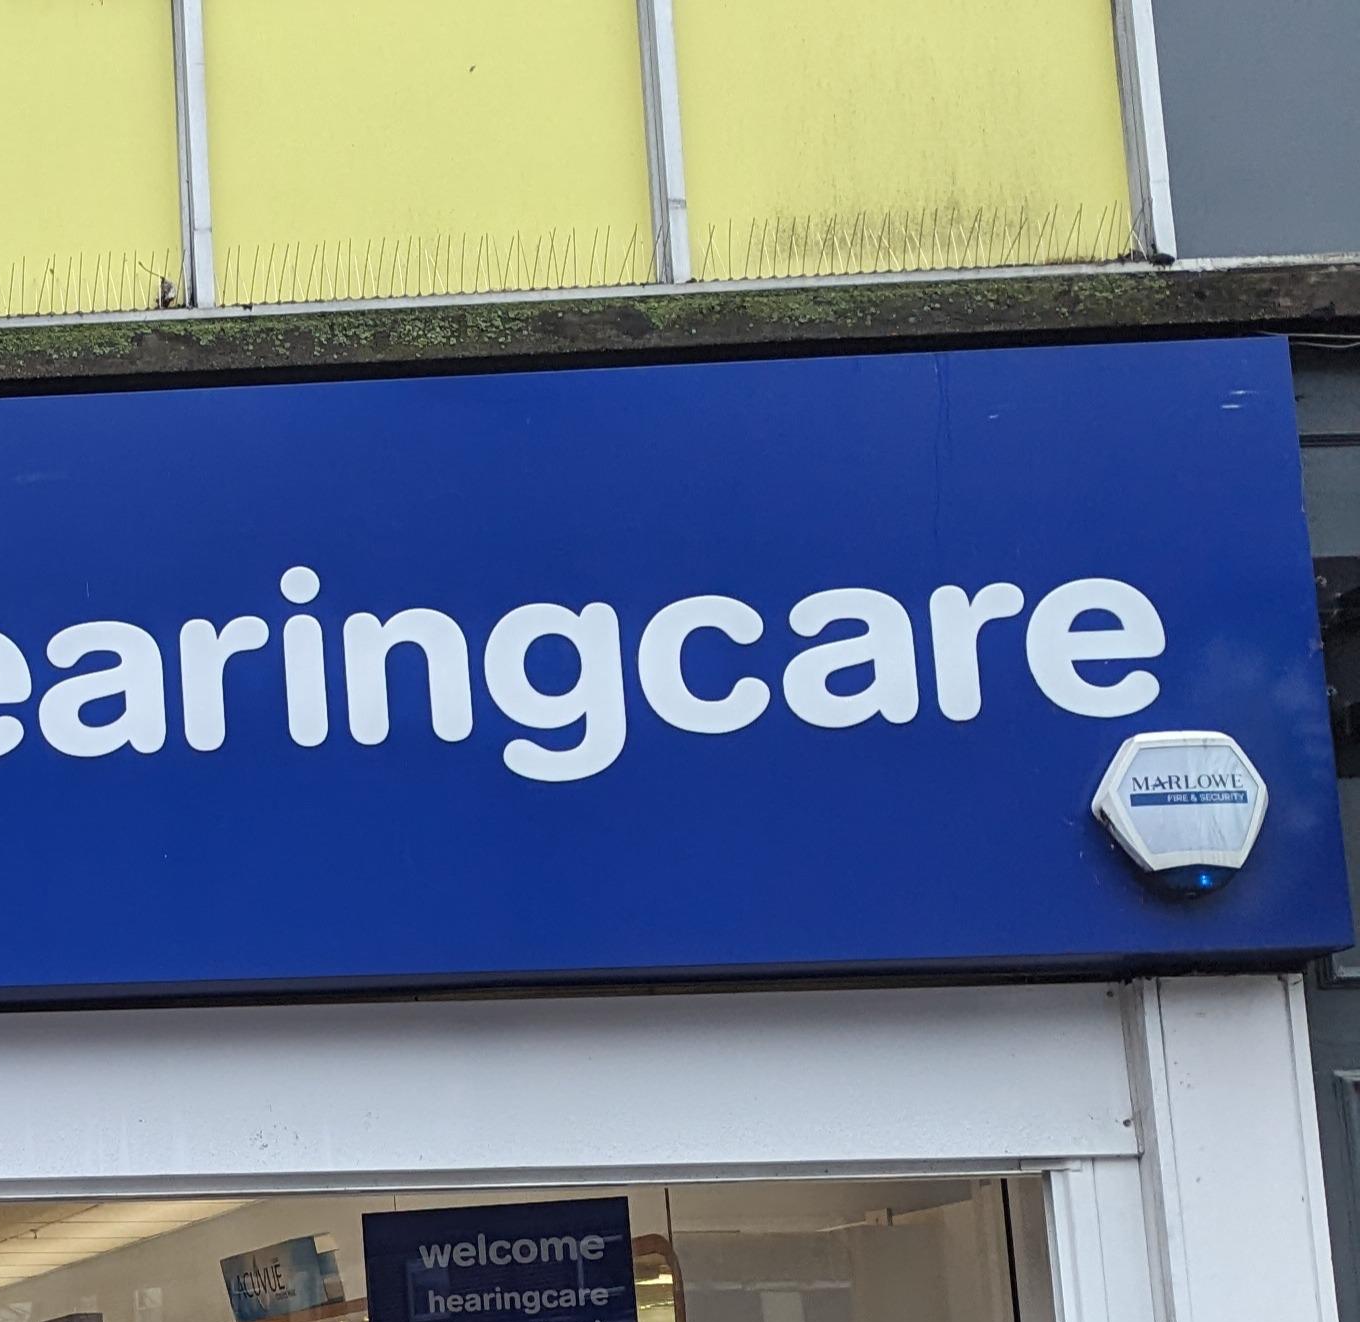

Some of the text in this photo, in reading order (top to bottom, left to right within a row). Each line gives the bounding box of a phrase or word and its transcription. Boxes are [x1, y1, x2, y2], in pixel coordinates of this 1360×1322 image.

[1131, 773, 1244, 792] MARLOWE
[1167, 792, 1245, 803] FIRE & SECURITY
[419, 1233, 605, 1269] welcome
[427, 1286, 609, 1315] hearingcare
